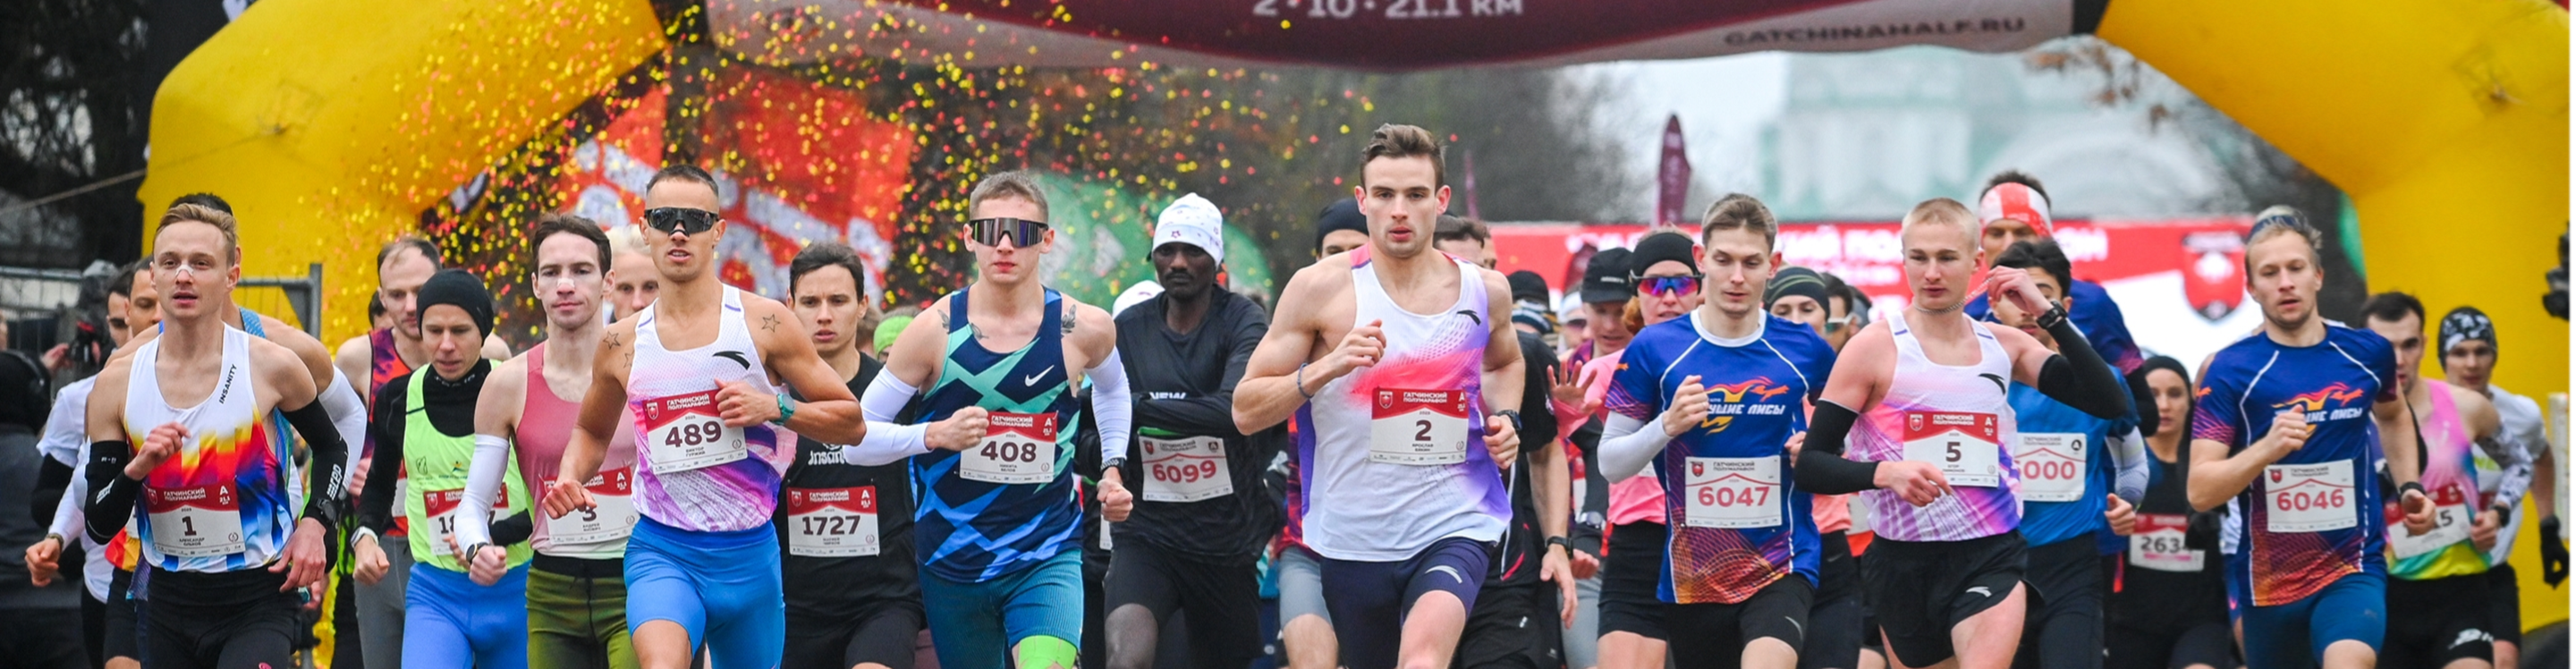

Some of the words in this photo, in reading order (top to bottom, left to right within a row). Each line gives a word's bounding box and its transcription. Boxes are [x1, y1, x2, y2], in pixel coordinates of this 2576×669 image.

[1724, 17, 2025, 44] GATCHINAHALF.RU
[218, 363, 237, 404] INSANITY
[666, 394, 709, 407] ГАТЧИНСКИЙ
[1747, 404, 1786, 415] ЛИСЫ
[665, 420, 722, 448] 489
[1415, 419, 1432, 441] 2
[980, 441, 1037, 462] 408
[1945, 442, 1962, 462] 5
[1152, 460, 1216, 483] 6099
[2015, 460, 2076, 480] 000
[164, 487, 205, 497] ГАТЧИНСКИЙ
[1698, 487, 1770, 507] 6047
[2276, 488, 2345, 512] 6046
[582, 505, 597, 522] 3
[182, 515, 197, 536] 1
[802, 515, 860, 536] 1727
[2140, 536, 2192, 554] 263
